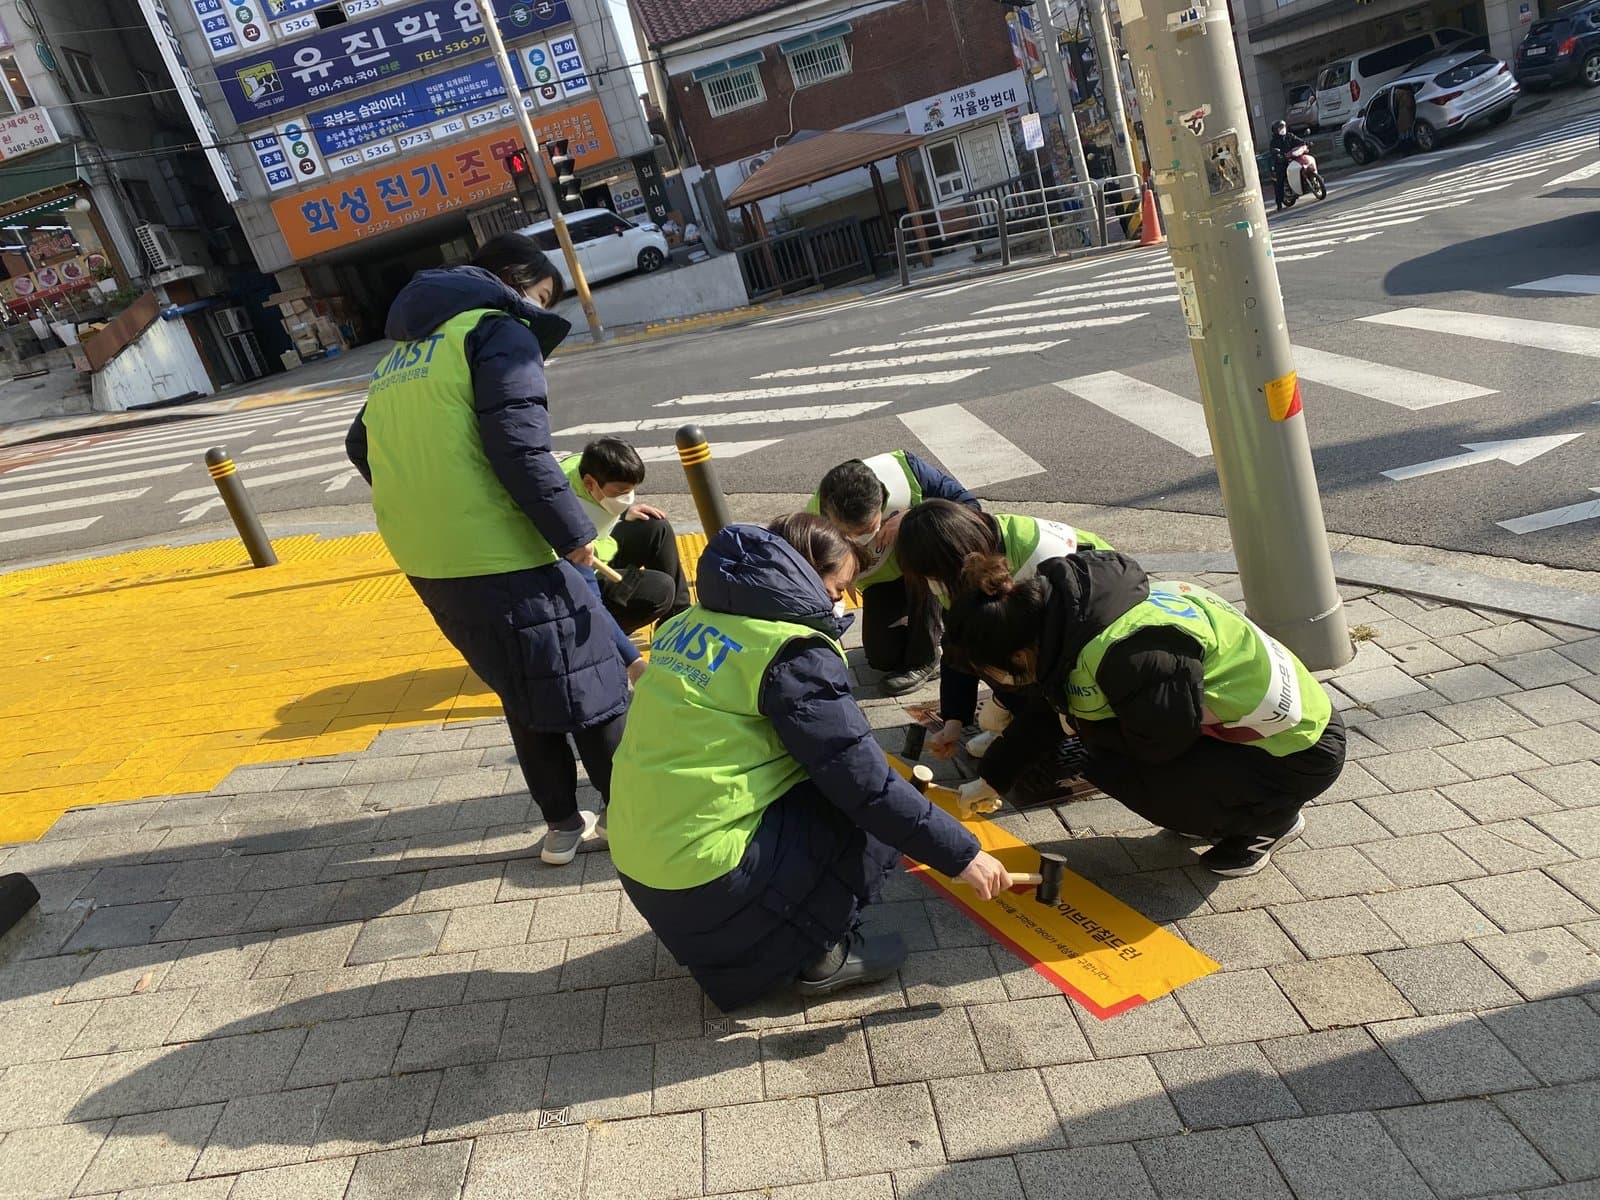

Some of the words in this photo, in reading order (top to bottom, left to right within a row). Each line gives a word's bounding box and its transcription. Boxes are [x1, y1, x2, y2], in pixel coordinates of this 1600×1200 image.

[207, 16, 226, 30] 수학
[246, 27, 258, 38] 고
[416, 50, 443, 63] TEL:
[445, 29, 504, 54] 536-973
[323, 110, 357, 127] 공부는
[358, 92, 407, 119] 습관이다!
[952, 87, 1017, 119] 자율방범대
[400, 131, 431, 148] 9733
[436, 196, 463, 212] FAX
[469, 181, 514, 201] 591-72
[1057, 899, 1143, 961] 이브더칠드런
